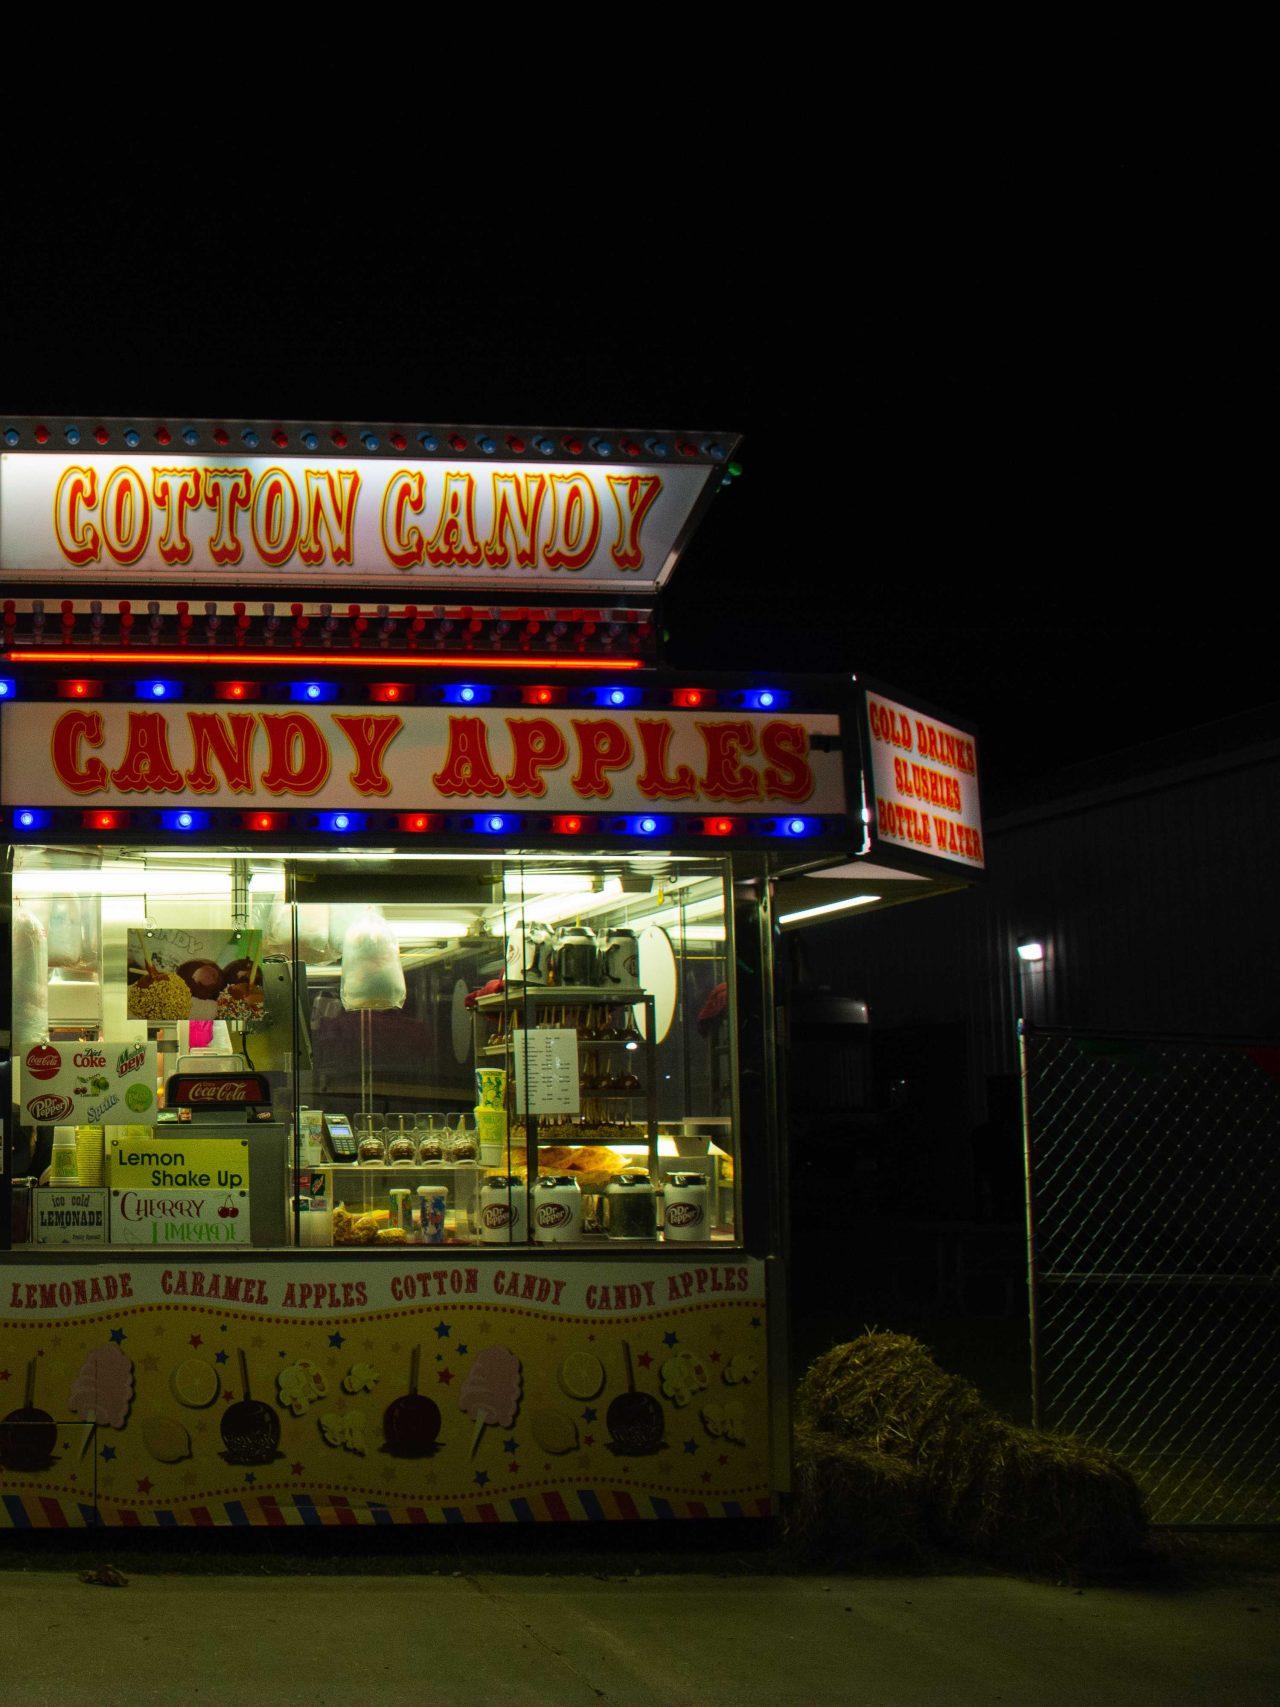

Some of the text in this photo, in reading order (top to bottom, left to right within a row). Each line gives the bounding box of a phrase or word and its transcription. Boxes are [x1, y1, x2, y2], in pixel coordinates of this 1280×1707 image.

[53, 465, 665, 571] COTTON CANDY
[869, 700, 976, 777] COLD DRINKS
[51, 710, 816, 804] CANDY APPLES
[894, 756, 962, 812] SLUSHIES
[877, 797, 983, 861] BOTTLE WATER
[73, 1053, 107, 1068] Coke
[84, 1047, 102, 1057] Diet
[32, 1101, 64, 1118] Pepper
[188, 1081, 248, 1102] Coca-Cola
[118, 1149, 185, 1166] Lemon
[151, 1170, 243, 1189] Shake Up
[39, 1210, 103, 1227] LEMONADE
[71, 1194, 90, 1208] cold
[9, 1273, 133, 1309] LEMONADE
[161, 1270, 368, 1308] CARAMEL APPLES
[391, 1269, 566, 1306] COTTON CANDY
[586, 1267, 748, 1310] CANDY APPLES
